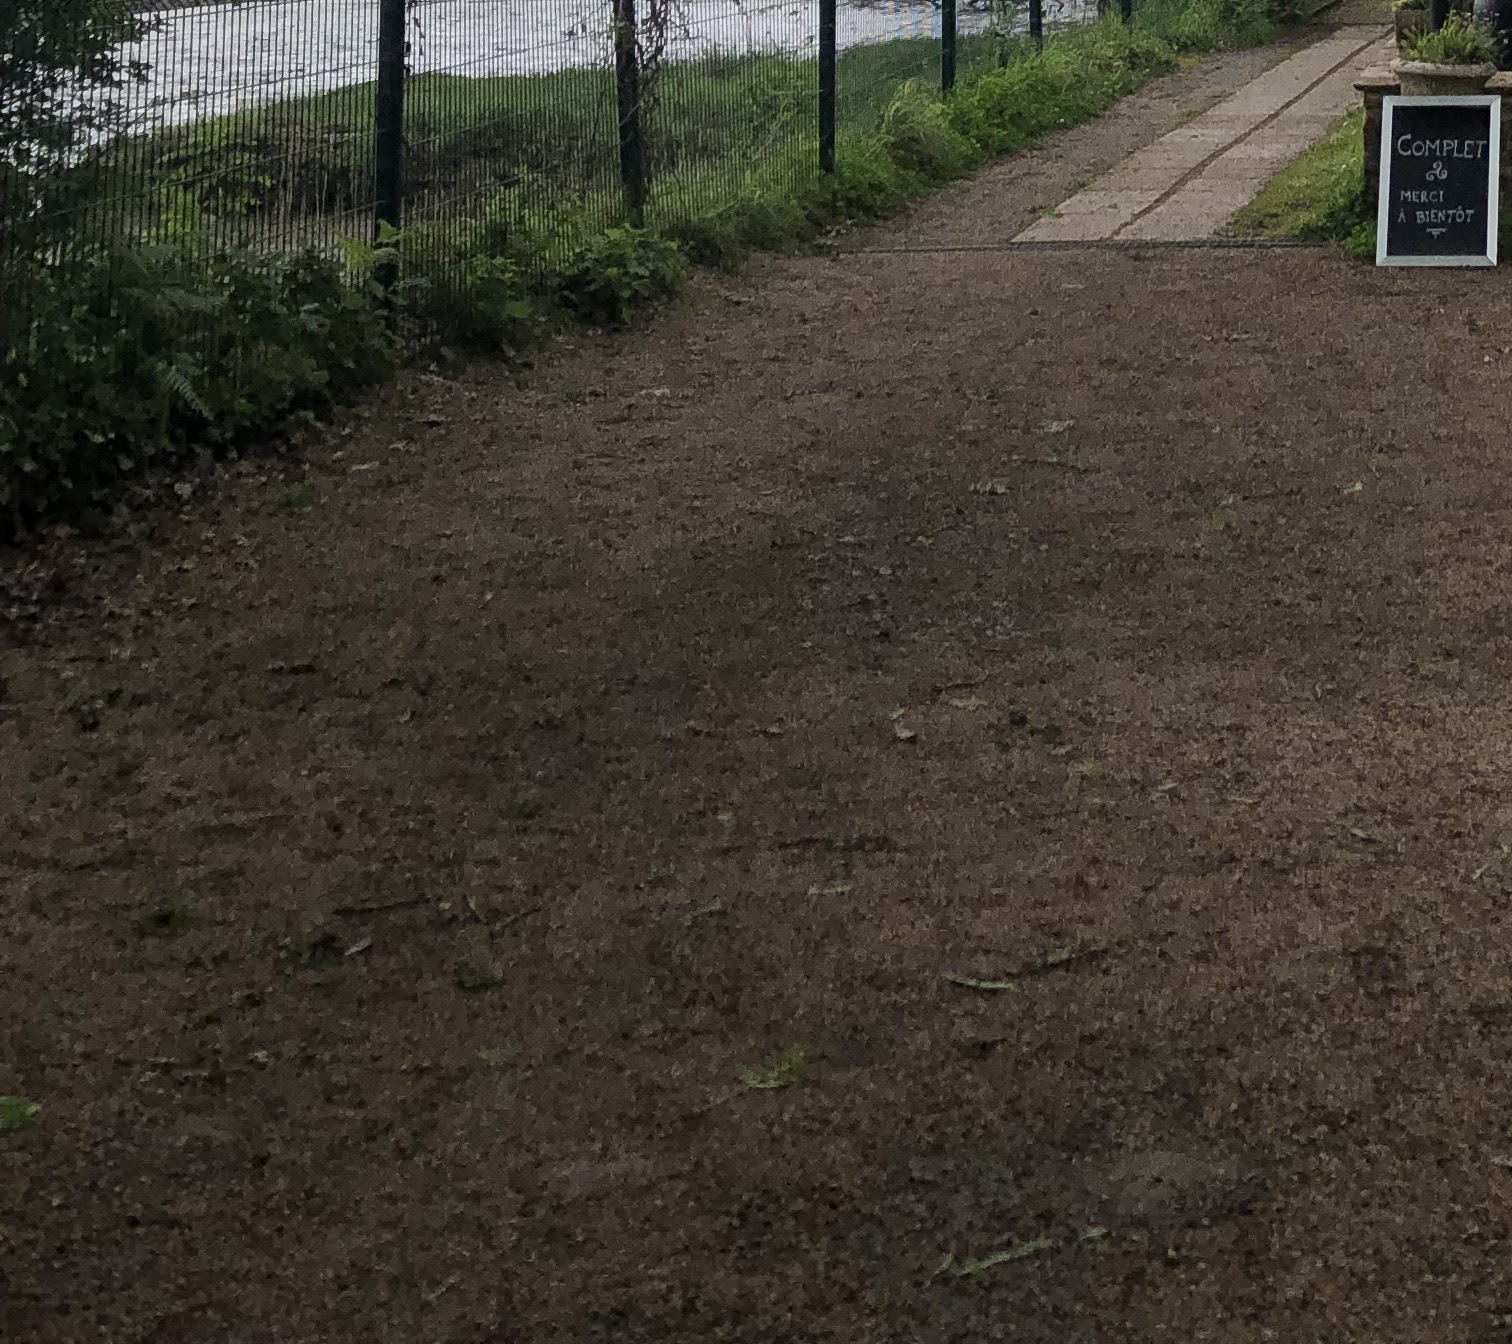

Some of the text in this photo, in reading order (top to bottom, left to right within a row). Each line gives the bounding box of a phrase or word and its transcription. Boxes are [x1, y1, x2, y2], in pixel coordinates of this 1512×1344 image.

[1397, 133, 1488, 159] COMPLET
[1400, 190, 1445, 203] MERCI
[1416, 205, 1475, 224] BIENTÔT
